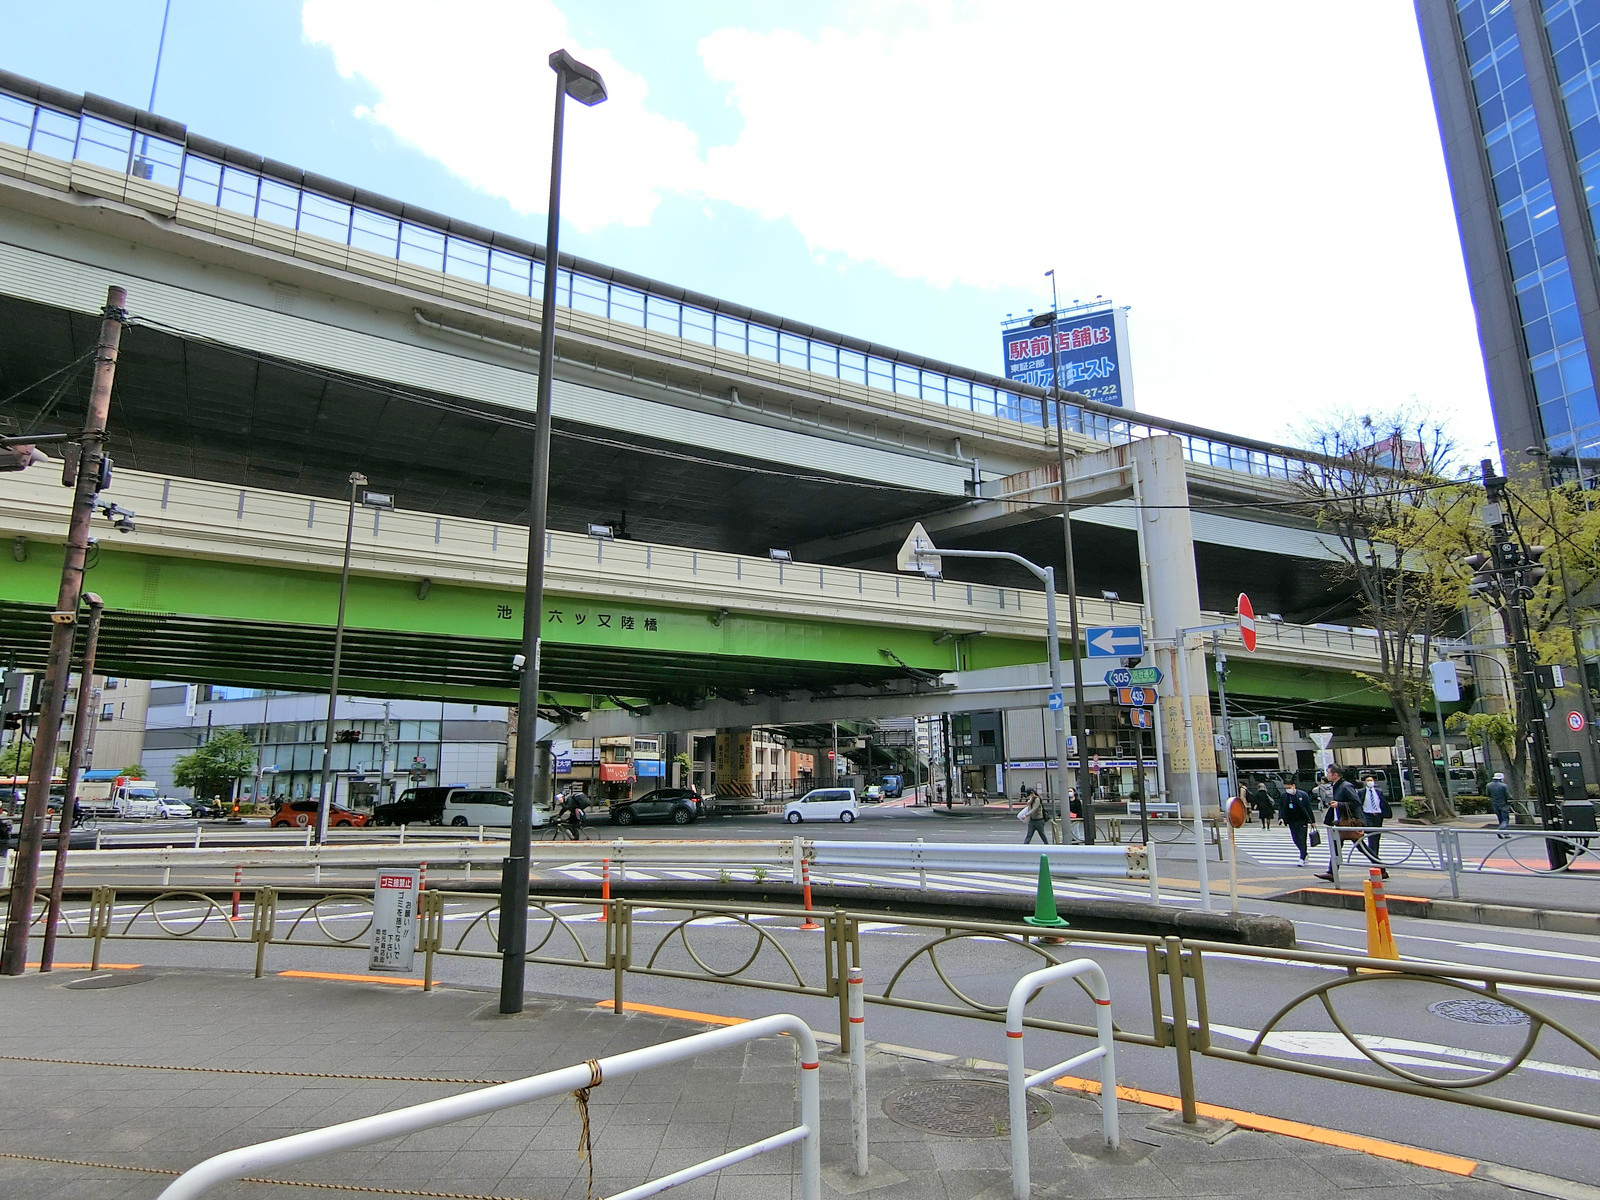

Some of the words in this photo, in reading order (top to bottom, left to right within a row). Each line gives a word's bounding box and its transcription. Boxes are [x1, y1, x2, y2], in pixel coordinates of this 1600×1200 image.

[1009, 327, 1110, 360] 駅前店舗は
[1010, 359, 1045, 373] 東証2部
[496, 604, 659, 633] 池六ツ又陸橋
[1113, 672, 1130, 684] 305
[1131, 690, 1144, 702] 435
[394, 891, 404, 960] ゴミを捨てないで
